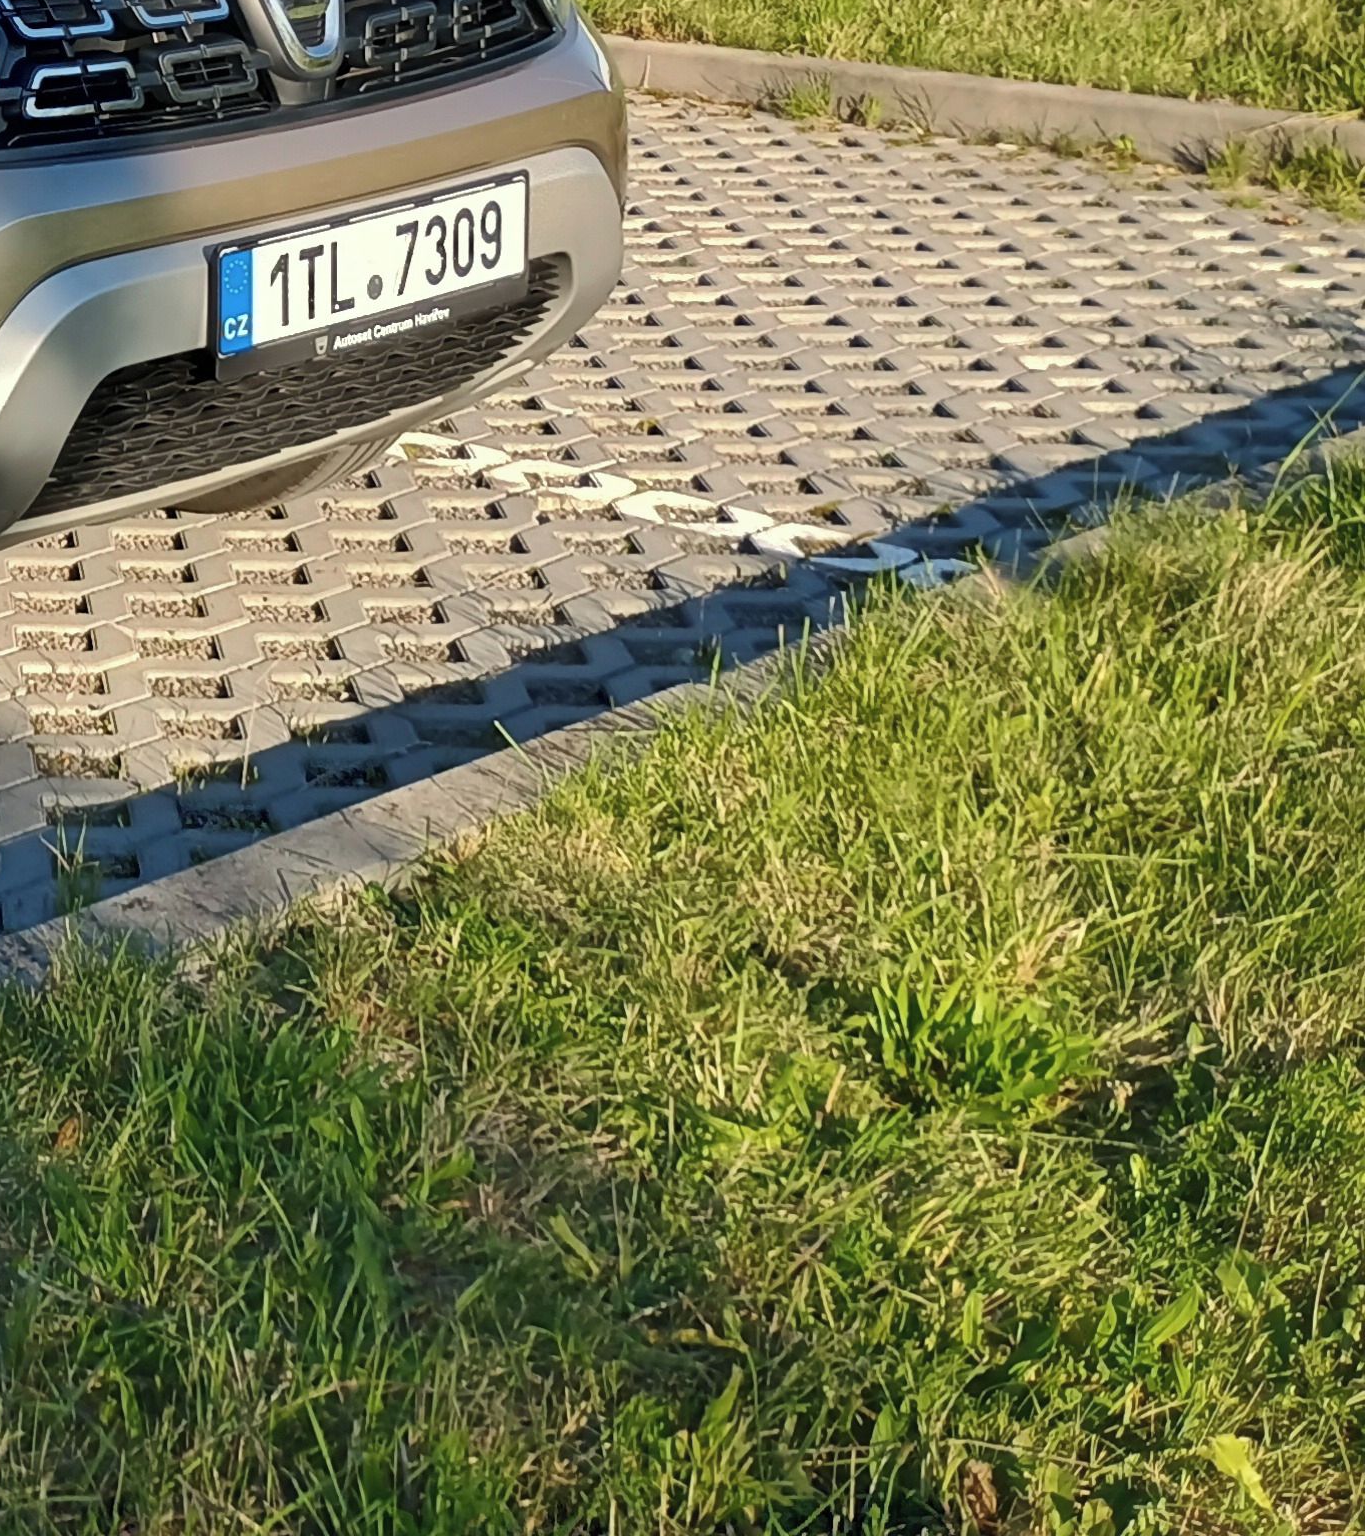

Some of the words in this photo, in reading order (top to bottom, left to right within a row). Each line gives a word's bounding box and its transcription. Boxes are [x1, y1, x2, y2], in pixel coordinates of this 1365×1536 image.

[270, 241, 356, 327] 1TL
[395, 200, 503, 297] 7309
[222, 313, 250, 341] CZ
